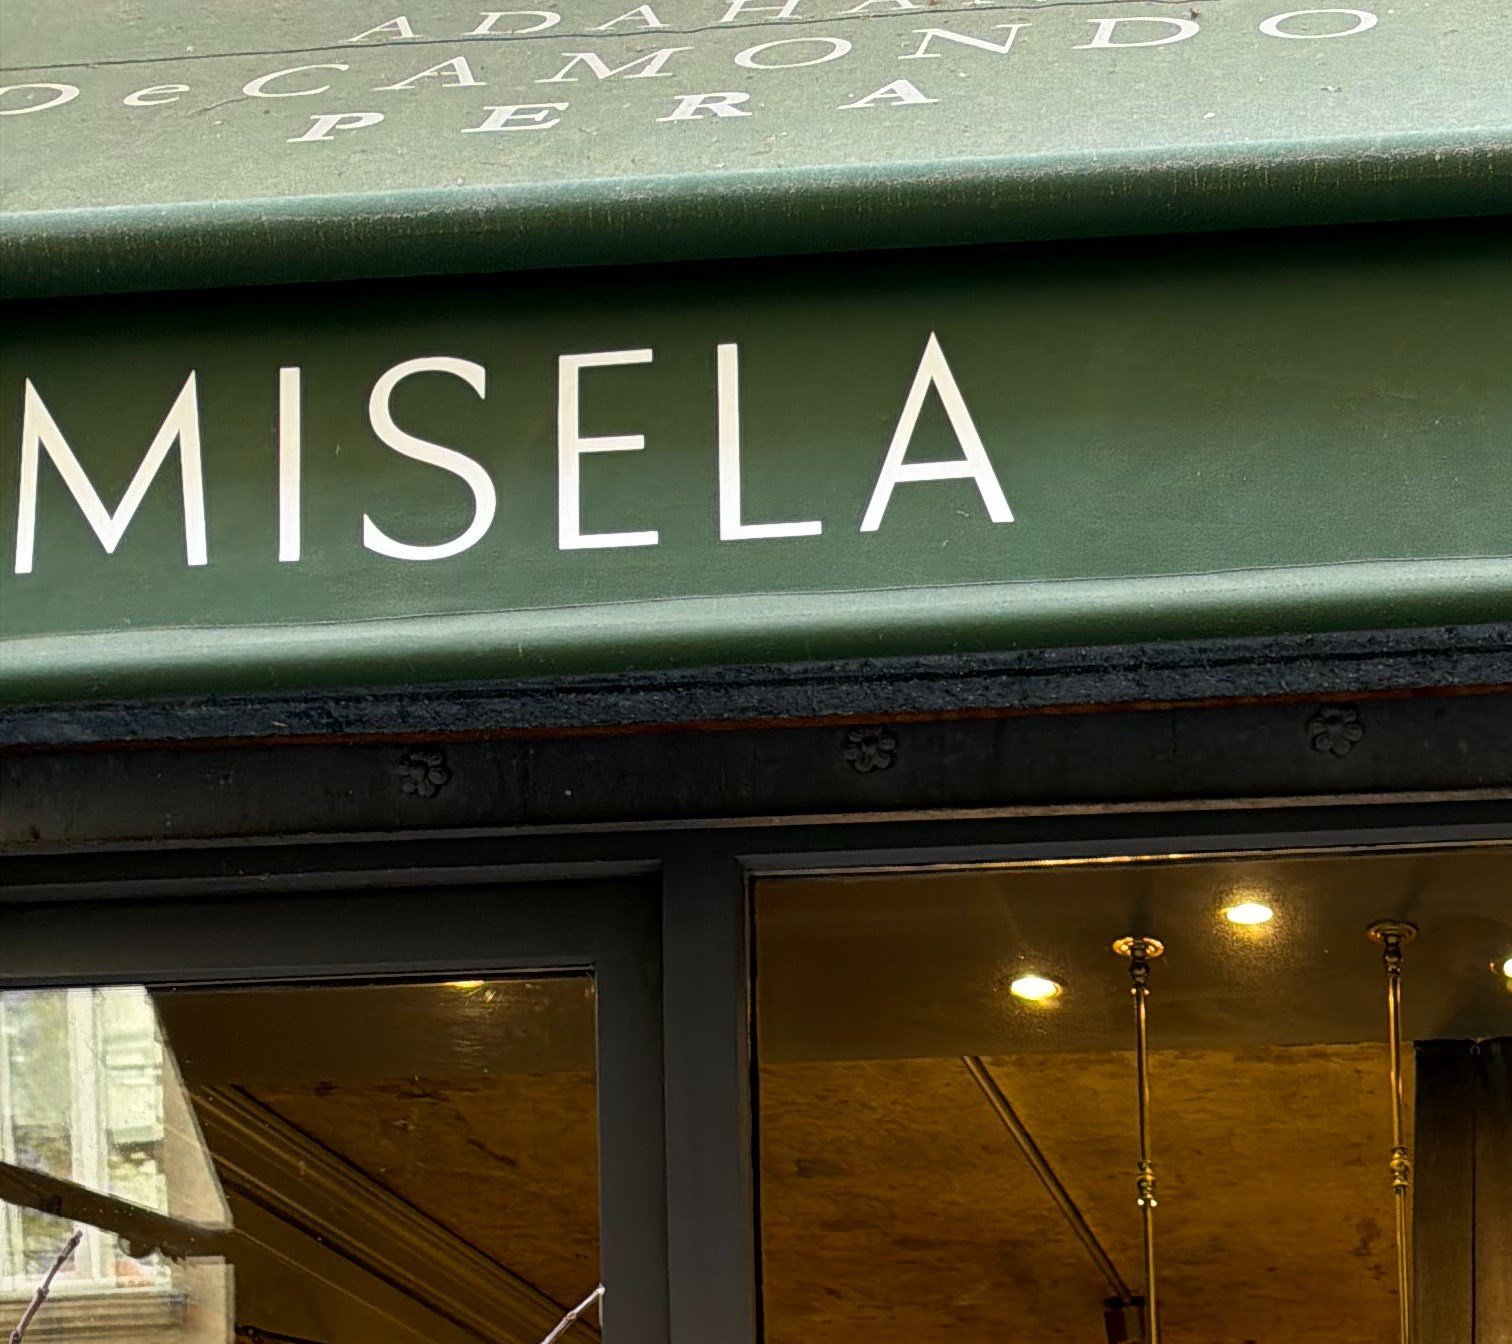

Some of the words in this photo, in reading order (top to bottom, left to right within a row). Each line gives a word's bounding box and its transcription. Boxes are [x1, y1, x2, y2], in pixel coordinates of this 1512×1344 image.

[347, 0, 994, 43] ADAHA
[287, 79, 938, 142] PERA
[15, 331, 1014, 574] MISELA
